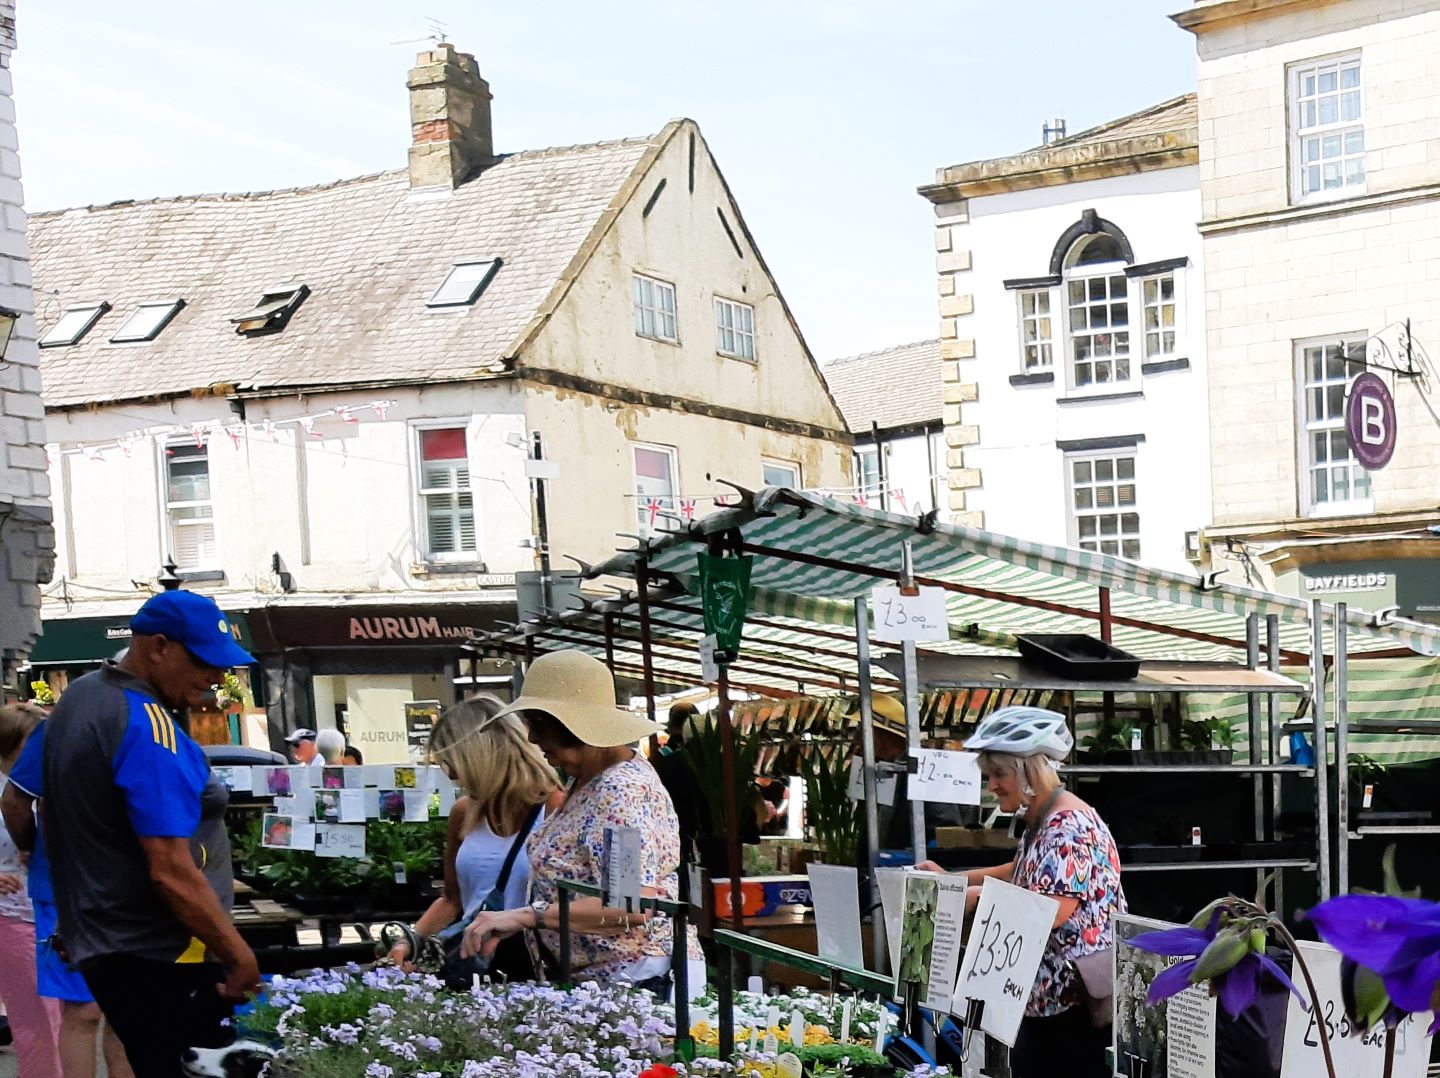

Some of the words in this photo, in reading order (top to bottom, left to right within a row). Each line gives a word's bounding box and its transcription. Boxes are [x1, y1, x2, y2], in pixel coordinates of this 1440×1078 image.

[1361, 396, 1386, 446] B
[479, 575, 515, 585] CASTLEG
[1305, 573, 1386, 590] BAYFIELDS
[351, 616, 441, 640] AURUM
[360, 731, 406, 743] AURUM
[967, 903, 1023, 981] £3.50
